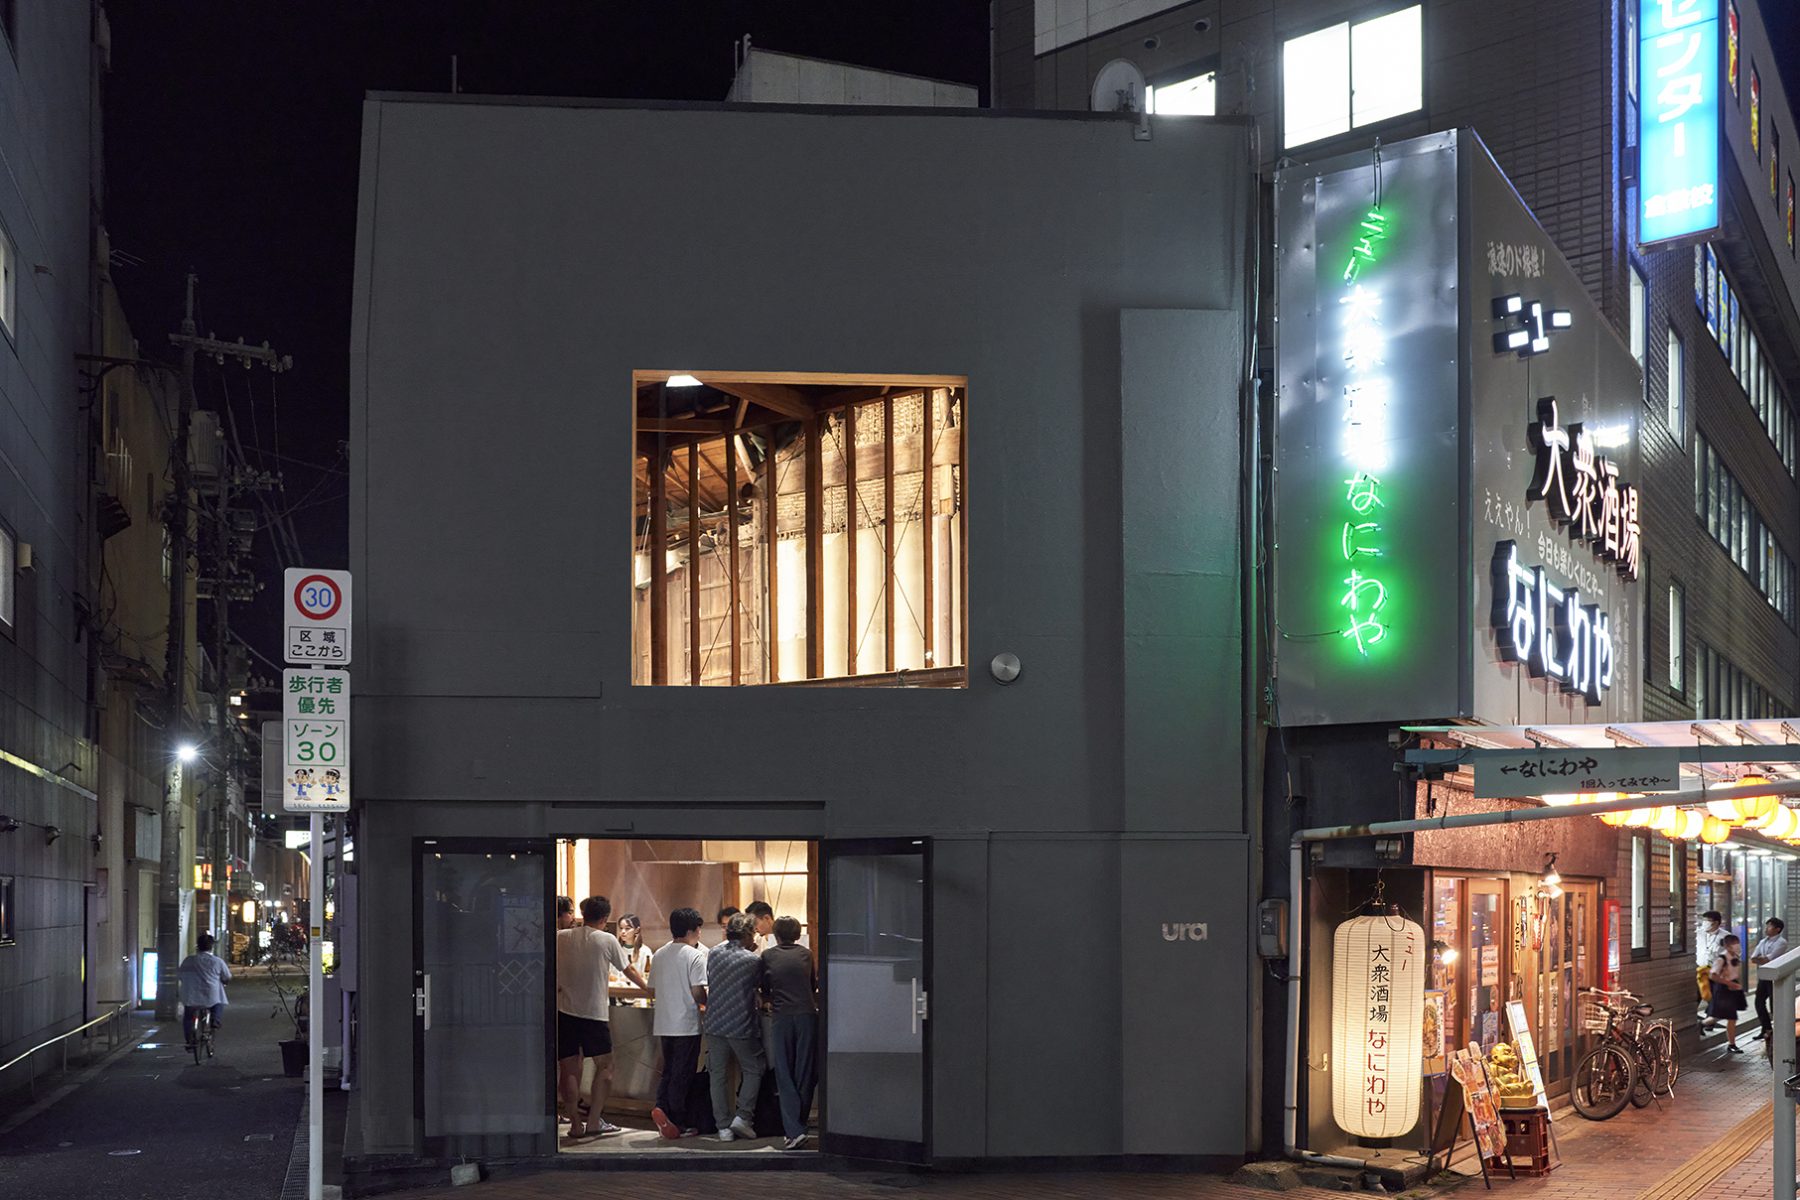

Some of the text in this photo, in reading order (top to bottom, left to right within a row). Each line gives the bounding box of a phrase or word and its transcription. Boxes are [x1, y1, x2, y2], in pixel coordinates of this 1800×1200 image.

[1541, 399, 1641, 580] 大衆酒場
[304, 586, 333, 609] 30
[1507, 543, 1614, 706] なにわや
[300, 630, 336, 643] 区域
[291, 644, 344, 658] ここから
[288, 675, 344, 694] 歩行者
[297, 696, 336, 715] 優先
[294, 723, 339, 738] ゾーン
[296, 741, 337, 762] 30
[1518, 756, 1599, 778] なにわや
[1161, 922, 1208, 942] ura
[1401, 930, 1416, 971] ニュー
